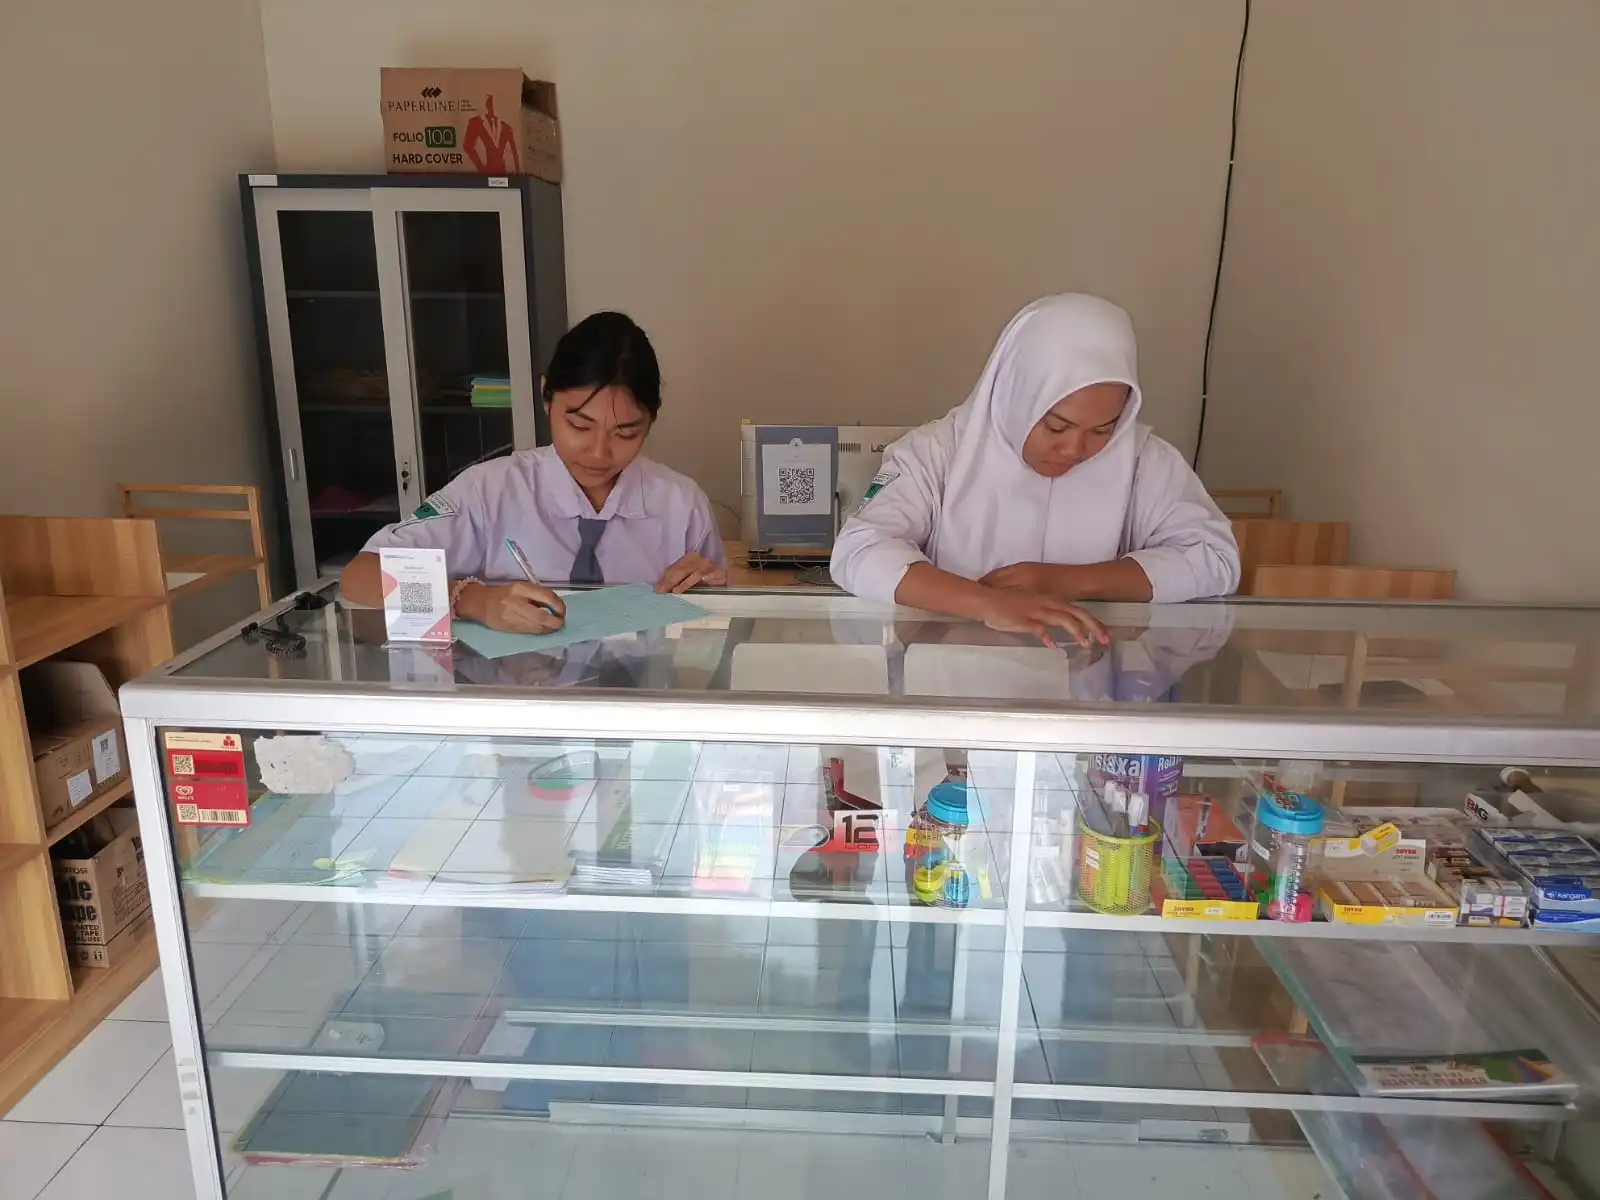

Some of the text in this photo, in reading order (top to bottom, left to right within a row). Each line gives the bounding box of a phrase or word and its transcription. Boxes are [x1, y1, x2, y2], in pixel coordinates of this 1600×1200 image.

[388, 101, 456, 112] PAPERLINE
[393, 132, 424, 142] FOLIO
[393, 153, 463, 164] HARD COVER
